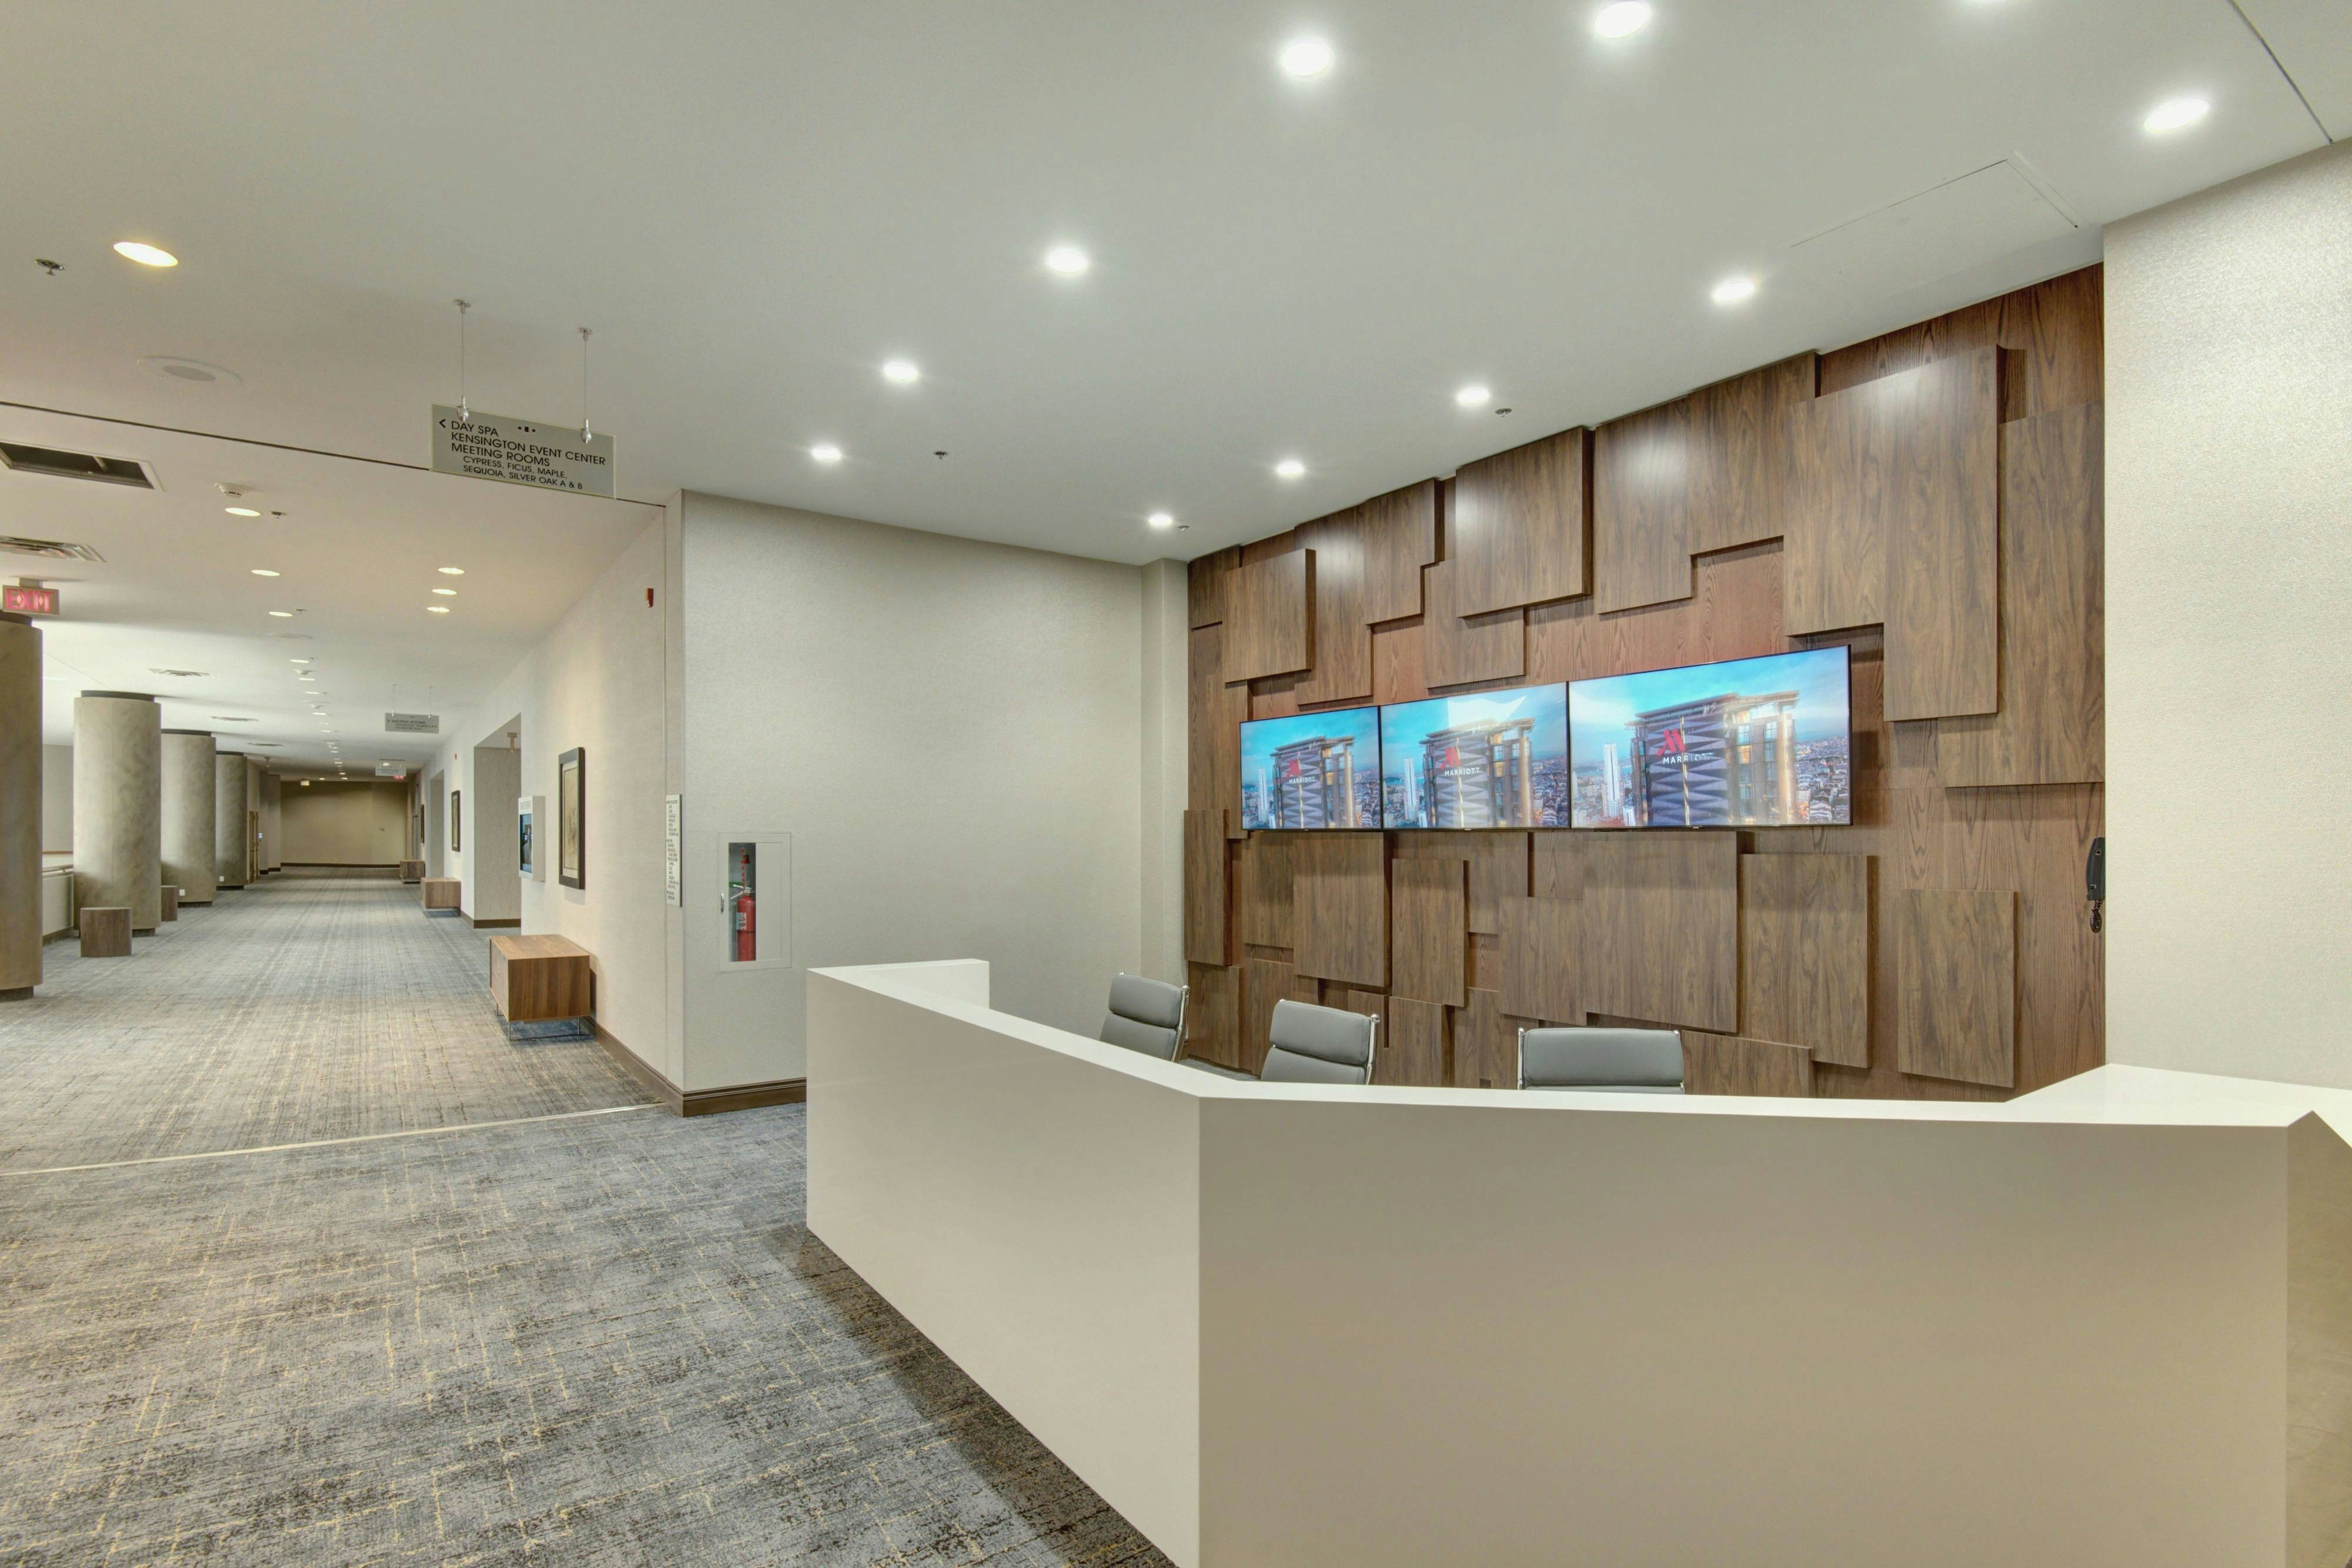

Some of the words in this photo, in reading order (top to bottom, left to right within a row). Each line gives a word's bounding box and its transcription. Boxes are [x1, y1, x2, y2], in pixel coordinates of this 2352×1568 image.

[452, 420, 475, 433] DAY
[478, 425, 499, 437] SPA
[452, 432, 526, 452] KENSINGTON
[530, 444, 562, 458] EVENT
[565, 452, 606, 466] CENTER
[452, 443, 503, 459] MEETING
[507, 452, 550, 467] ROOMS
[463, 456, 505, 469] CYPRESS,
[507, 462, 534, 474] FICUS,
[537, 467, 567, 479] MAPLE,
[463, 464, 506, 478] SEQUOIA,
[509, 472, 536, 482] SILVER
[539, 477, 557, 486] OAK
[6, 588, 55, 612] EXIT
[1662, 752, 1714, 765] MARRIOTT
[1445, 767, 1481, 777] MARRIOTT
